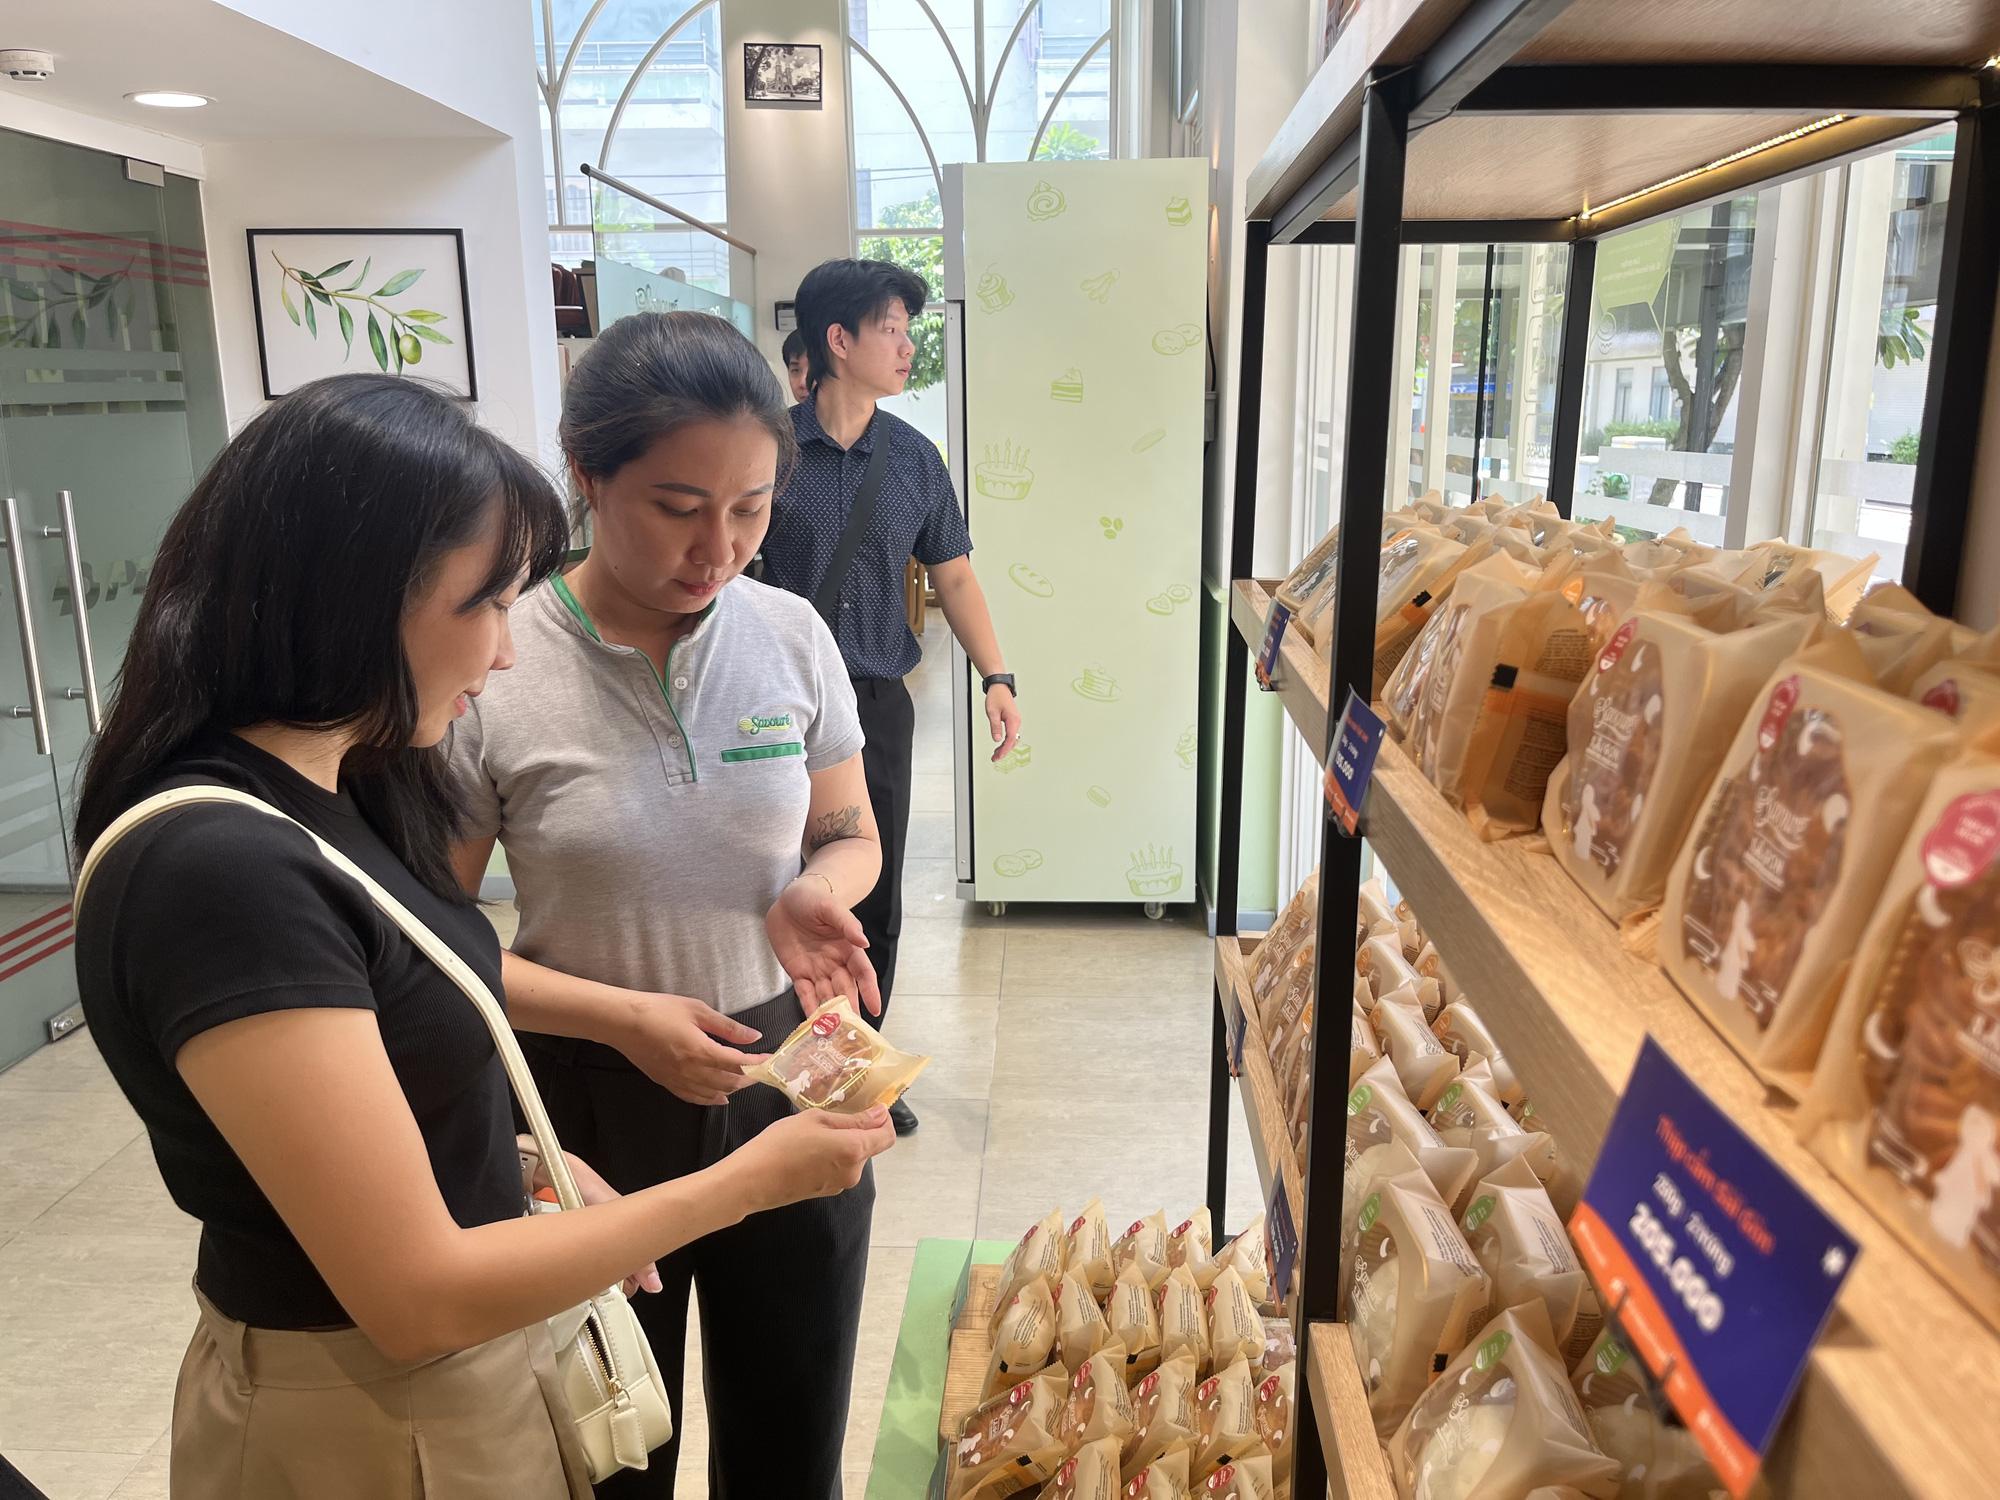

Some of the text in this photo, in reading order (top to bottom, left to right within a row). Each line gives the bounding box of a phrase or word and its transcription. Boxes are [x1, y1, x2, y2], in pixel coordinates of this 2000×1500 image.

[751, 713, 791, 735] Savouré
[817, 1037, 850, 1067] Savour
[1628, 1201, 1726, 1332] 205.000
